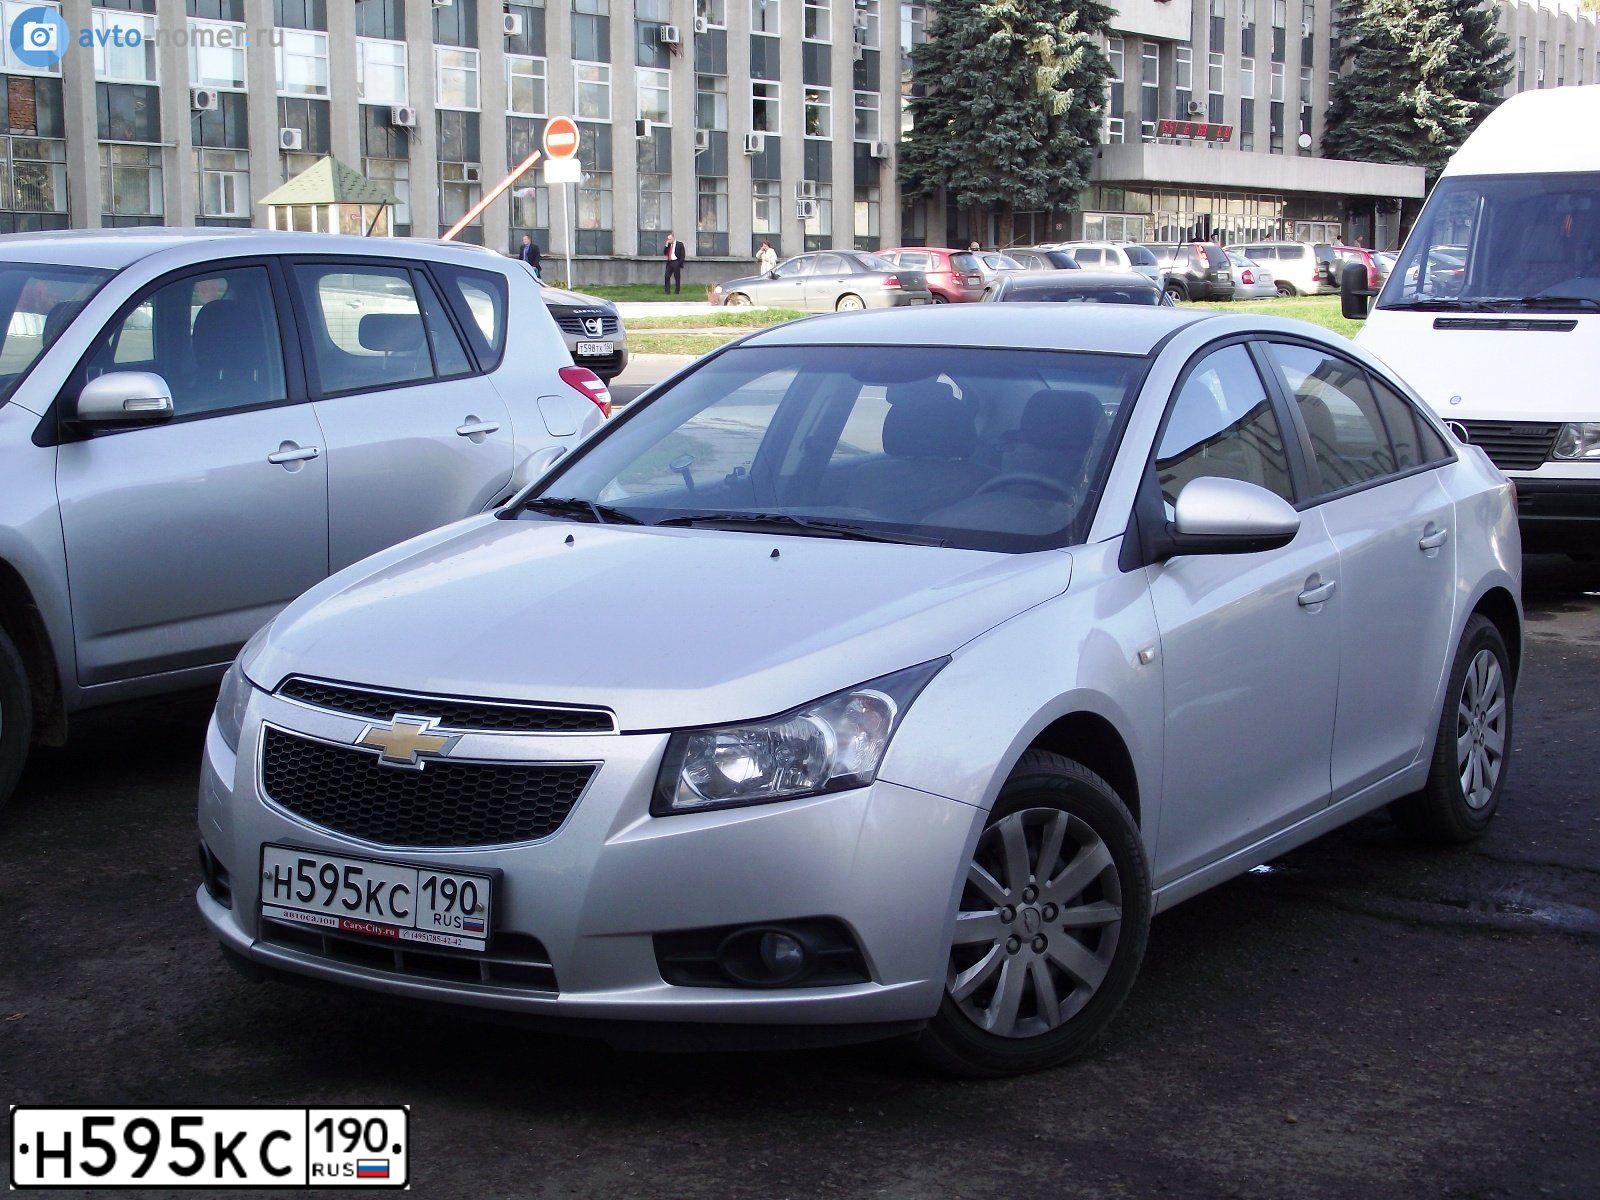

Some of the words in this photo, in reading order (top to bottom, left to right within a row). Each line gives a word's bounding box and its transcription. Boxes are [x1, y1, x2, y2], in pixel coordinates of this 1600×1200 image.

[274, 858, 411, 918] Н595КС
[421, 875, 478, 915] 190
[282, 910, 336, 927] автосалон
[433, 912, 462, 929] RUS
[343, 919, 395, 936] Cars-City.ru
